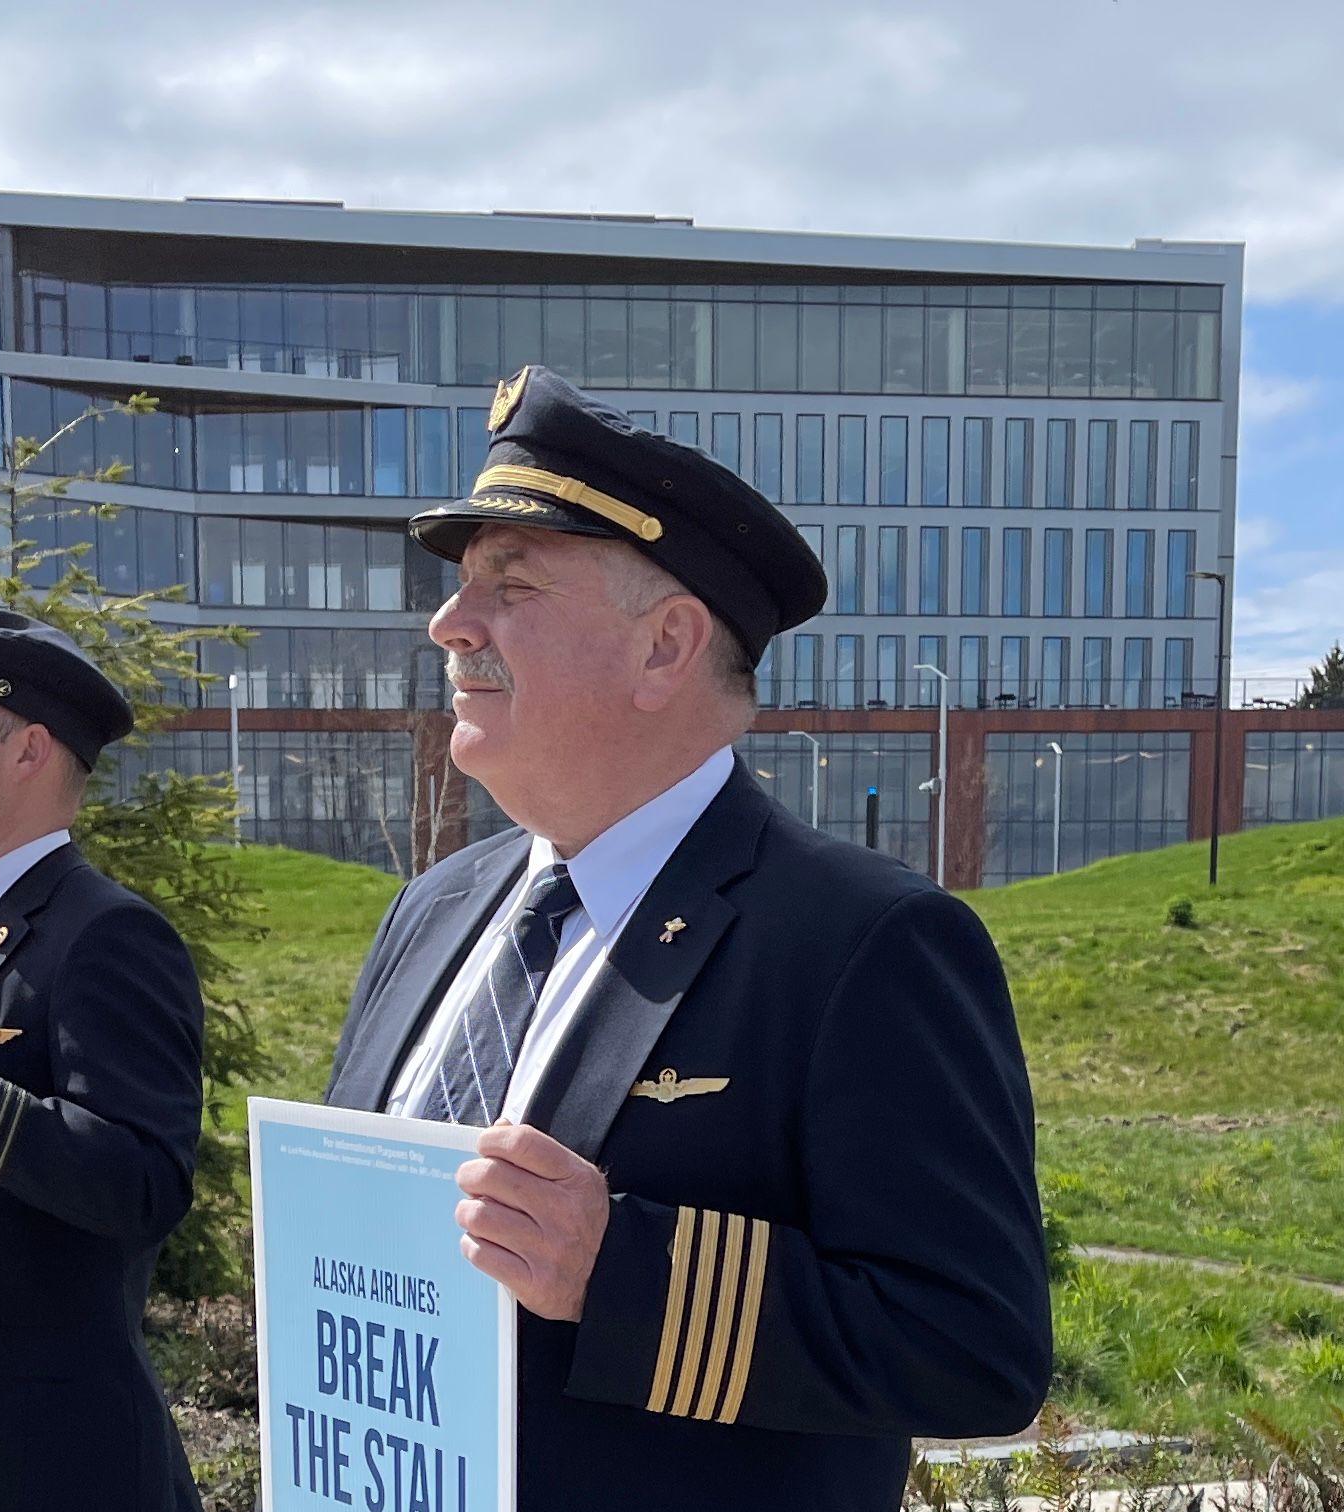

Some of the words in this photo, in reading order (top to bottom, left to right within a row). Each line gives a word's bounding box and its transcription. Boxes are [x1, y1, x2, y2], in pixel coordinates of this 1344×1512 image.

[313, 1256, 367, 1299] ALASKA
[370, 1268, 441, 1317] AIRLINES:
[316, 1308, 441, 1428] BREAK
[285, 1402, 353, 1506] THE
